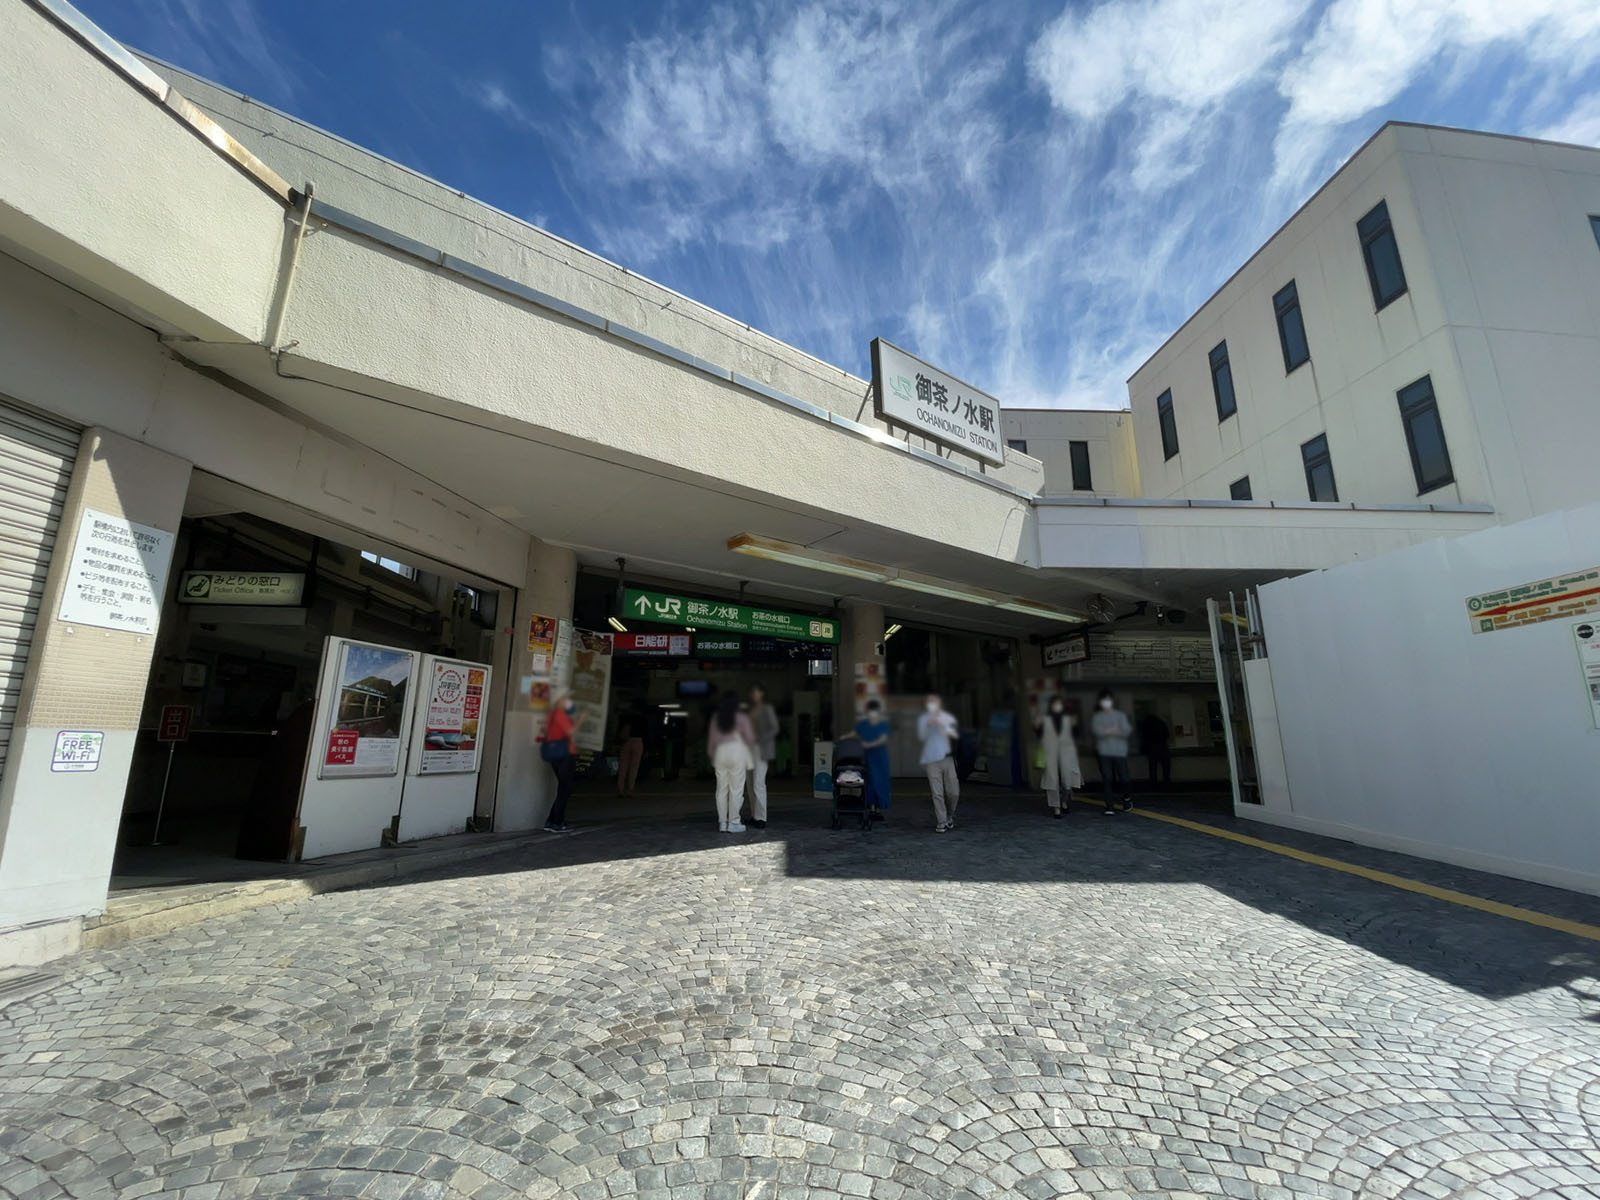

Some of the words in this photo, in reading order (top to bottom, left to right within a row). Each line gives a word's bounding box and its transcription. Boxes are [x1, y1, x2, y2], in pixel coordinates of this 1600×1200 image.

[915, 373, 995, 434] 御茶ノ水駅
[916, 407, 967, 439] OCHANOMIZU
[969, 431, 998, 453] STATION
[213, 575, 281, 587] みどりの窓口
[655, 598, 682, 616] JR
[687, 601, 739, 620] 御茶ノ水駅
[686, 615, 726, 627] Ochanomizu
[726, 620, 748, 630] Station
[752, 611, 791, 624] お茶の水橋口
[635, 634, 668, 648] 日能研
[62, 740, 92, 750] FREE
[61, 751, 90, 760] Wi-Fi
